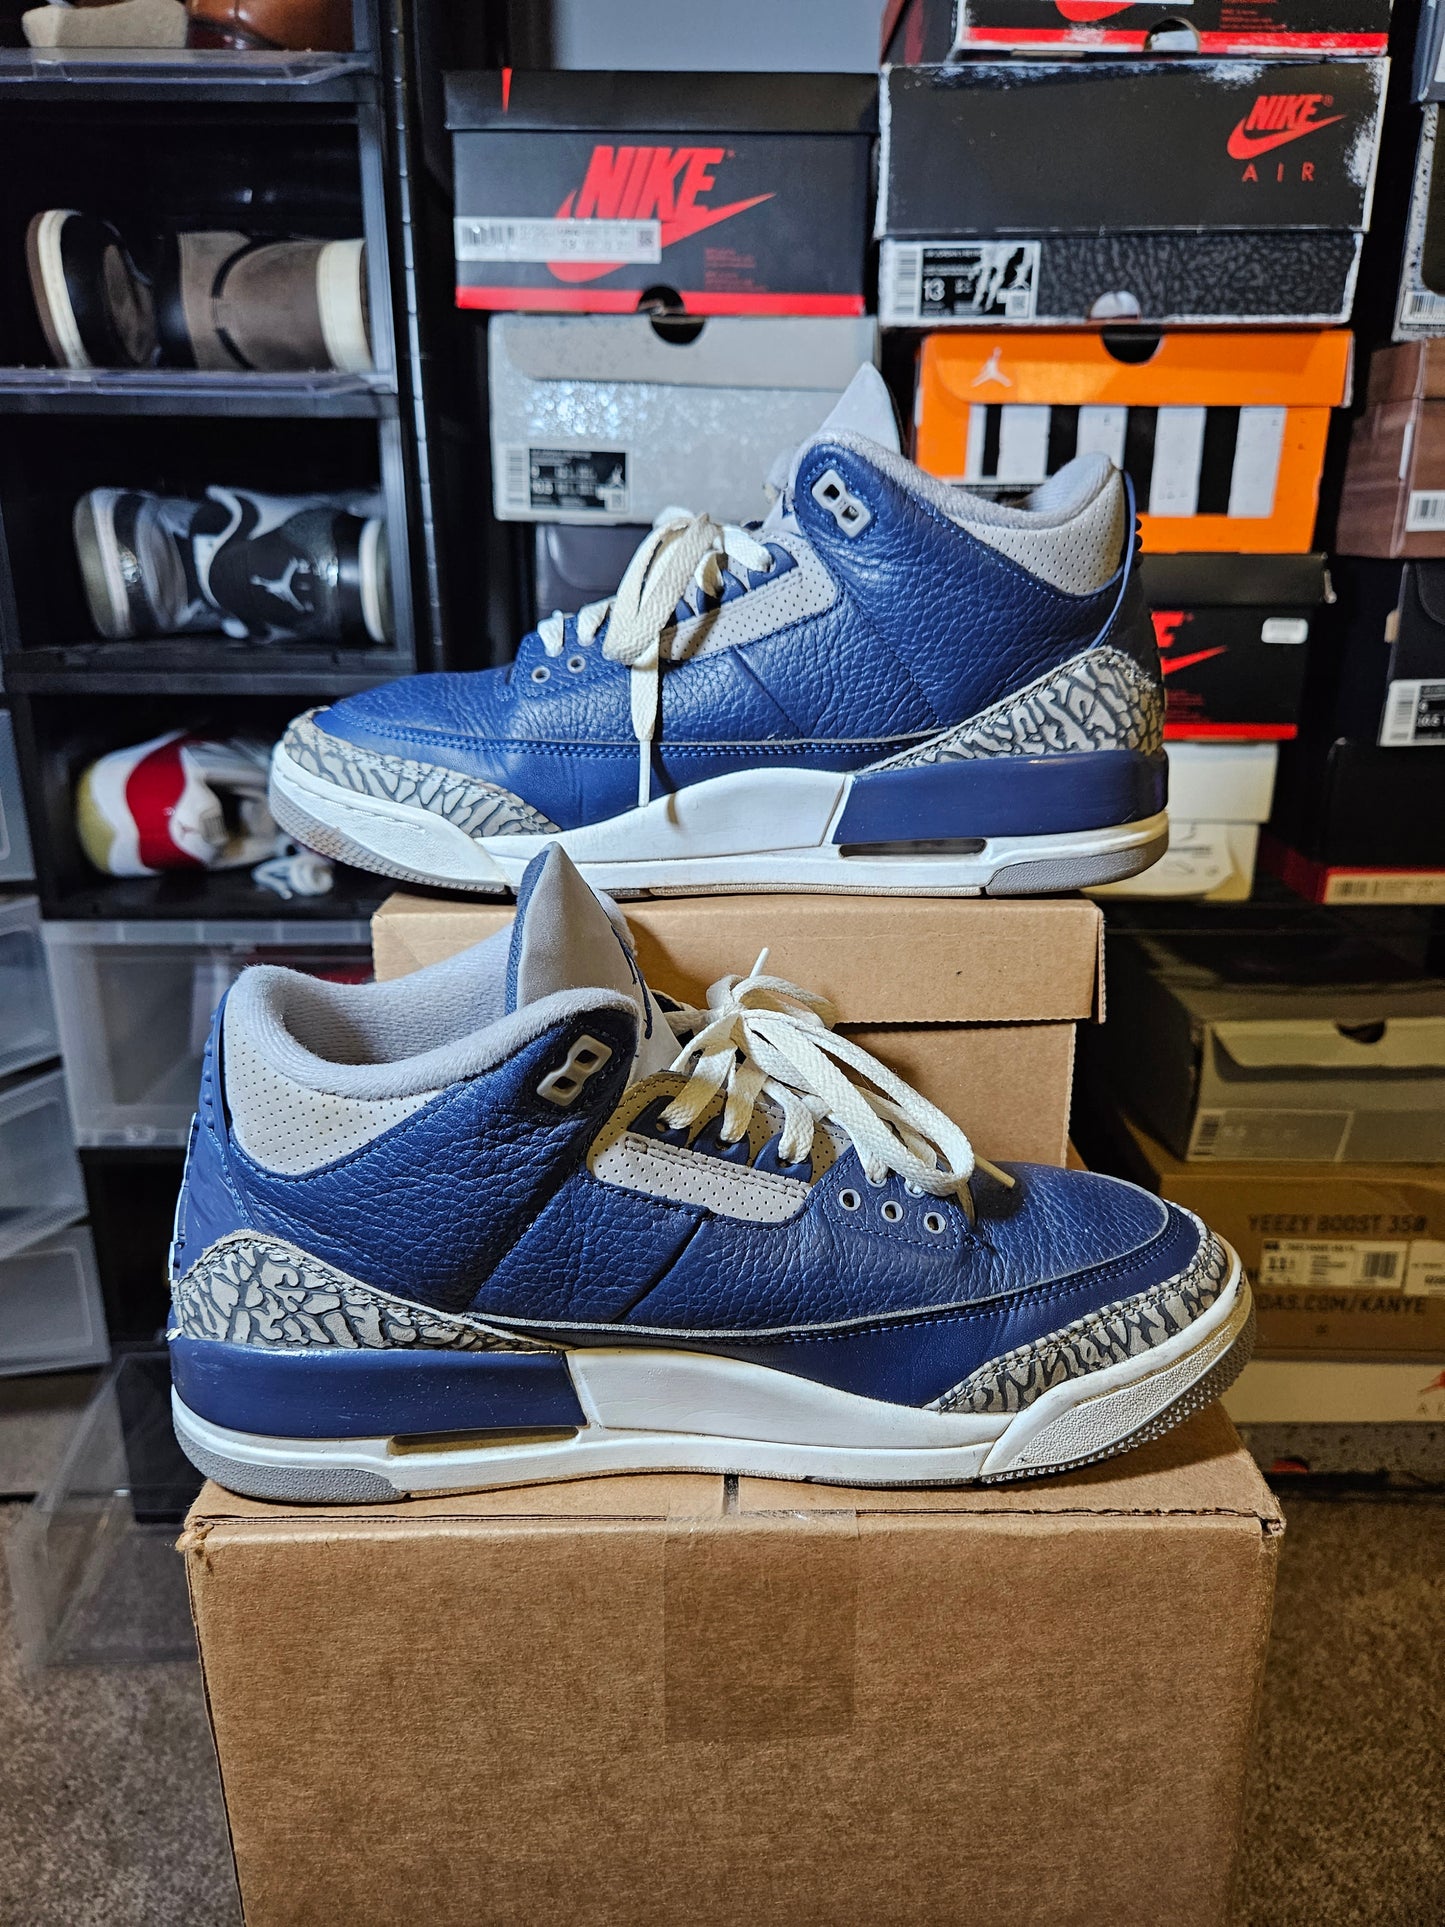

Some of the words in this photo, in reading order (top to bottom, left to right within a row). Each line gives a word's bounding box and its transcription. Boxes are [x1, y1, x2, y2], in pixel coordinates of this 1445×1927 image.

[1245, 94, 1323, 130] NIKE
[574, 146, 725, 220] NIKE
[1242, 162, 1314, 182] AIR
[924, 277, 945, 301] 13
[1249, 1214, 1311, 1232] YEEZY
[1317, 1215, 1382, 1232] BOOST
[1255, 1294, 1426, 1315] DAS.COM/KANYE
